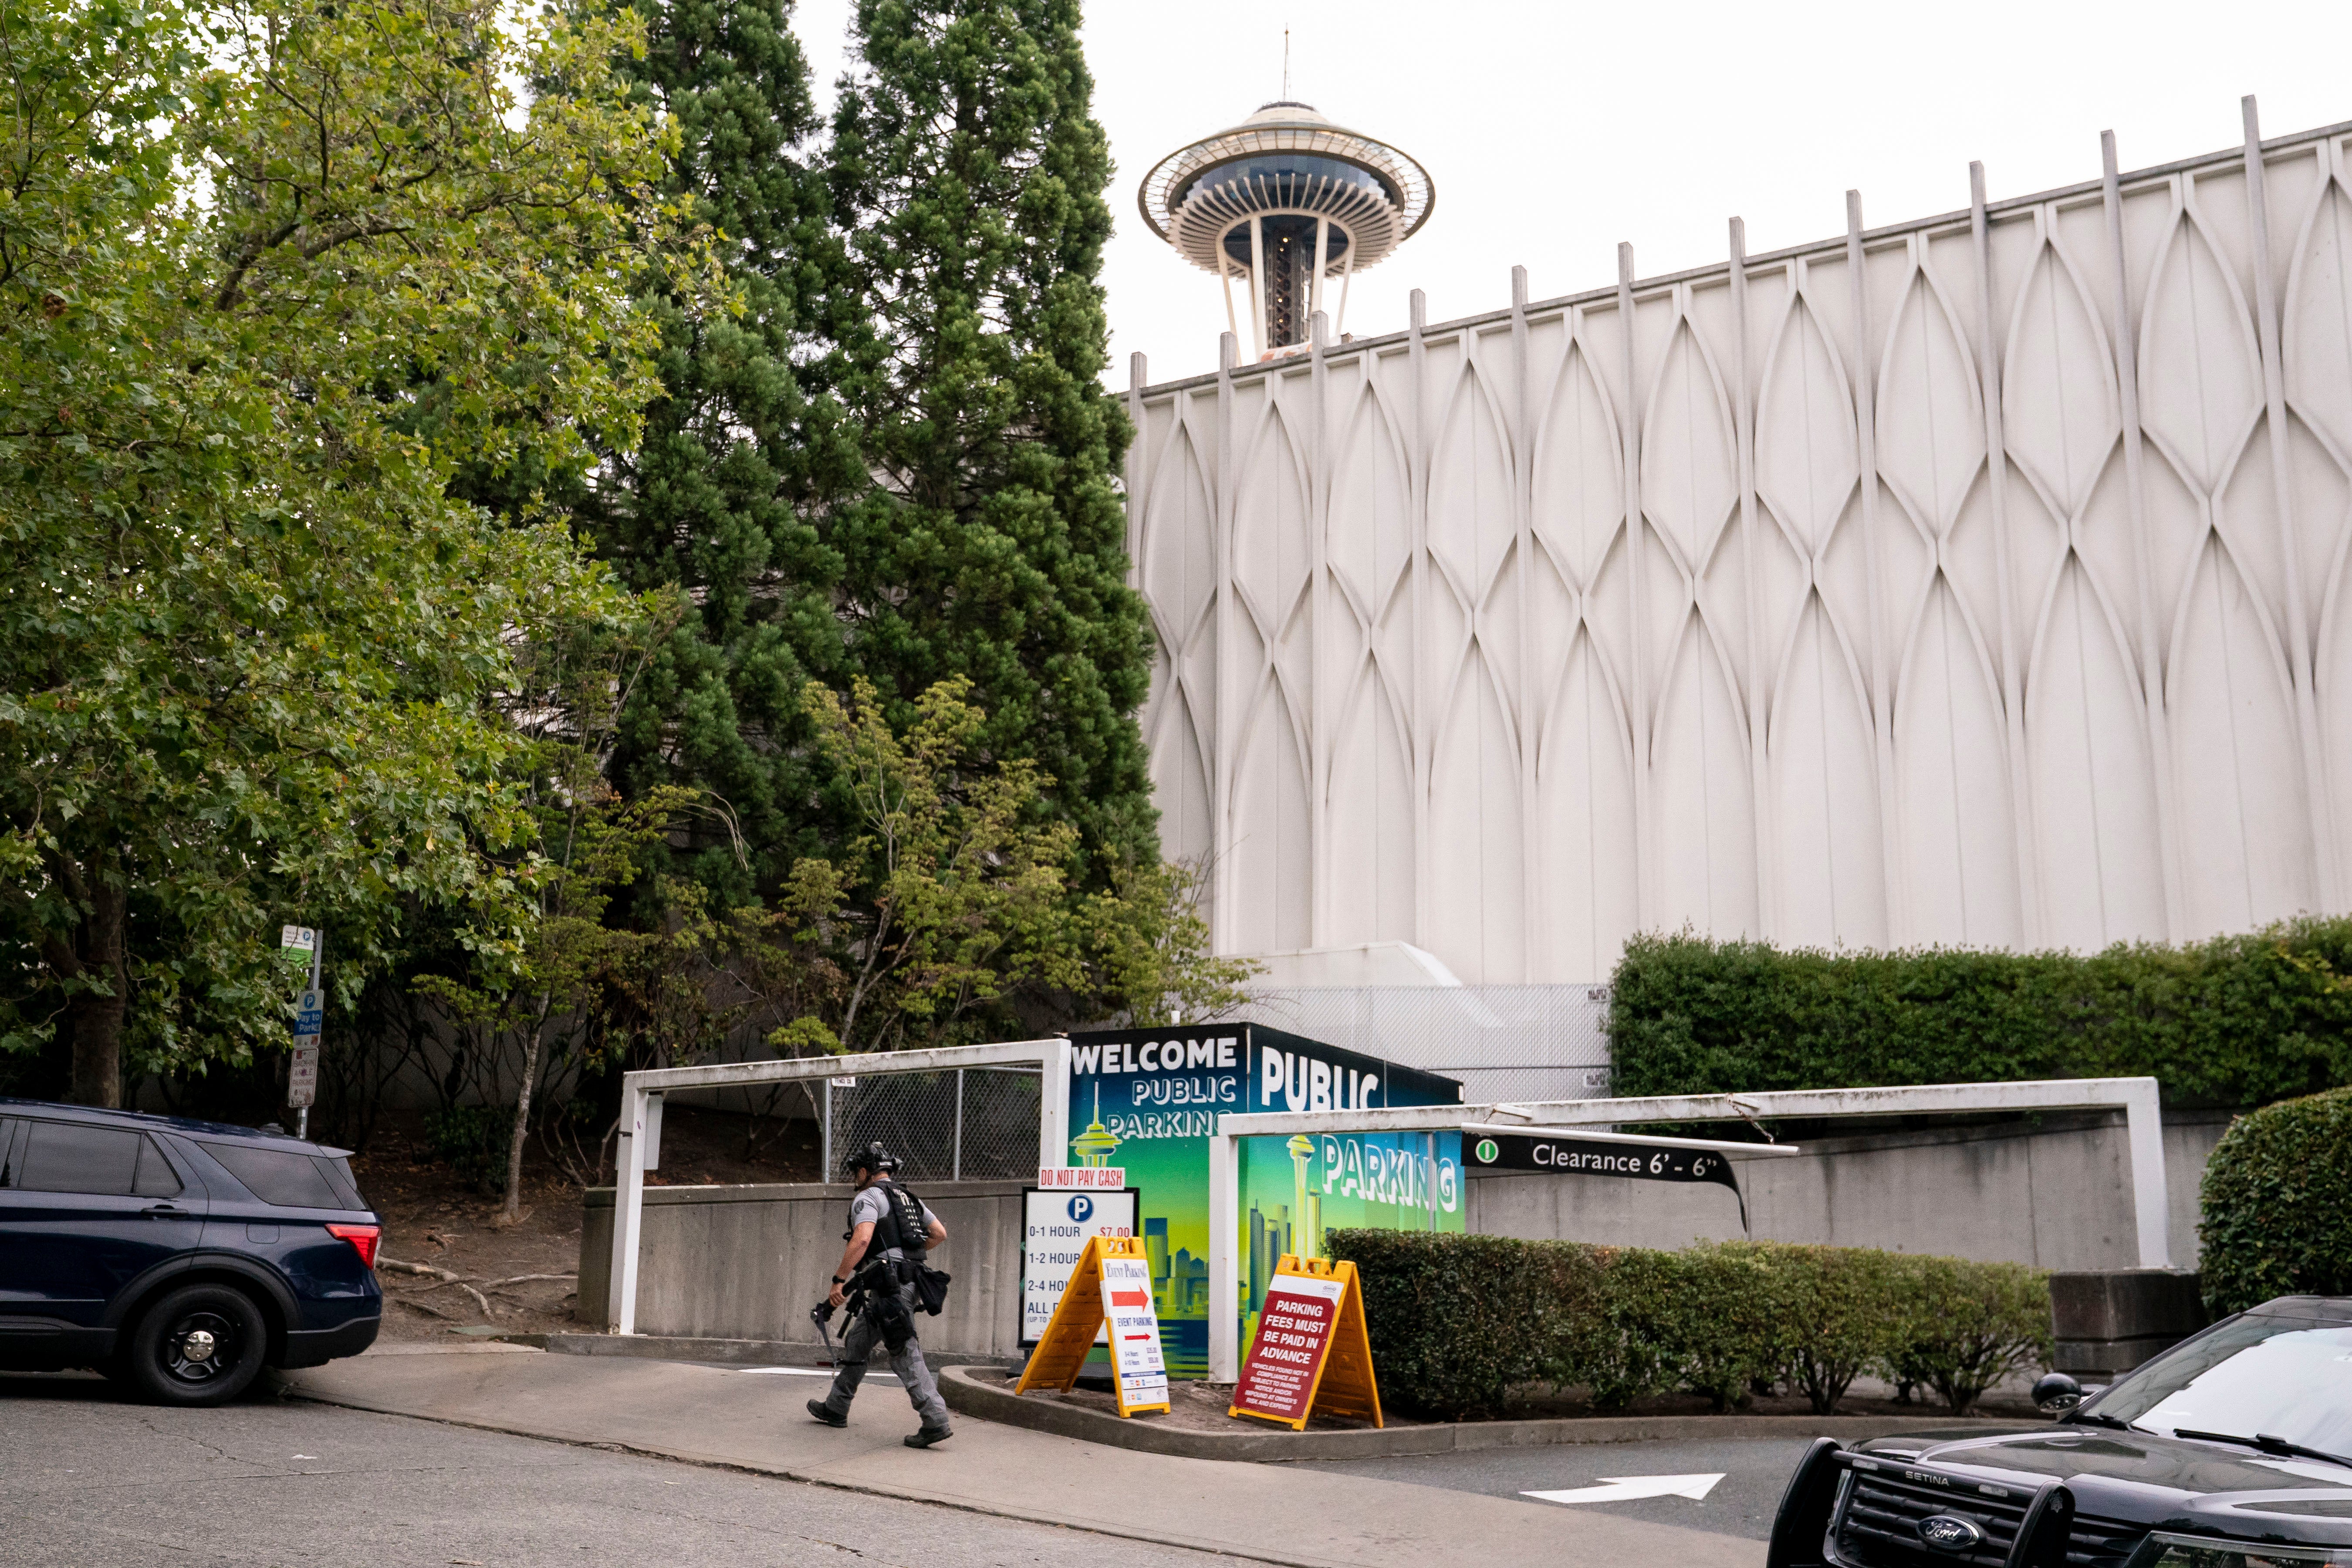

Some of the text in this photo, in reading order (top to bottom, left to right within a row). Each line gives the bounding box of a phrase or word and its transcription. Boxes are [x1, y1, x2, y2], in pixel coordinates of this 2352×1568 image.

[299, 1023, 317, 1032] Park
[1071, 1037, 1237, 1075] WELCOME
[1261, 1045, 1379, 1112] PUBLIC
[1132, 1075, 1236, 1106] PUBLIC
[1533, 1144, 1640, 1172] Clearance
[1649, 1153, 1669, 1174] 6'
[1041, 1170, 1122, 1186] DO NOT PAY CASH
[1321, 1134, 1456, 1212] PARKING
[1030, 1226, 1129, 1237] 0-1 HOUR $700
[1029, 1253, 1045, 1263] 1-2
[1028, 1280, 1044, 1291] 2-4
[1027, 1302, 1048, 1314] ALL
[1276, 1300, 1323, 1317] PARKING
[1117, 1317, 1152, 1327] EVENT PARKING
[1265, 1315, 1326, 1333] FEES MUST
[1263, 1330, 1319, 1349] BE PAID IN
[1259, 1346, 1312, 1364] ADVANCE
[1252, 1362, 1276, 1371] VEHICLES
[1250, 1376, 1273, 1385] SUBJECT
[1279, 1382, 1301, 1390] PARKING
[1257, 1370, 1289, 1381] COMPLIANCE
[1245, 1390, 1268, 1399] IMPOUND
[1254, 1385, 1274, 1393] NOTICE
[1269, 1402, 1292, 1411] EXPENSE
[1906, 1470, 1950, 1487] SETINA
[1925, 1521, 1962, 1541] Ford
